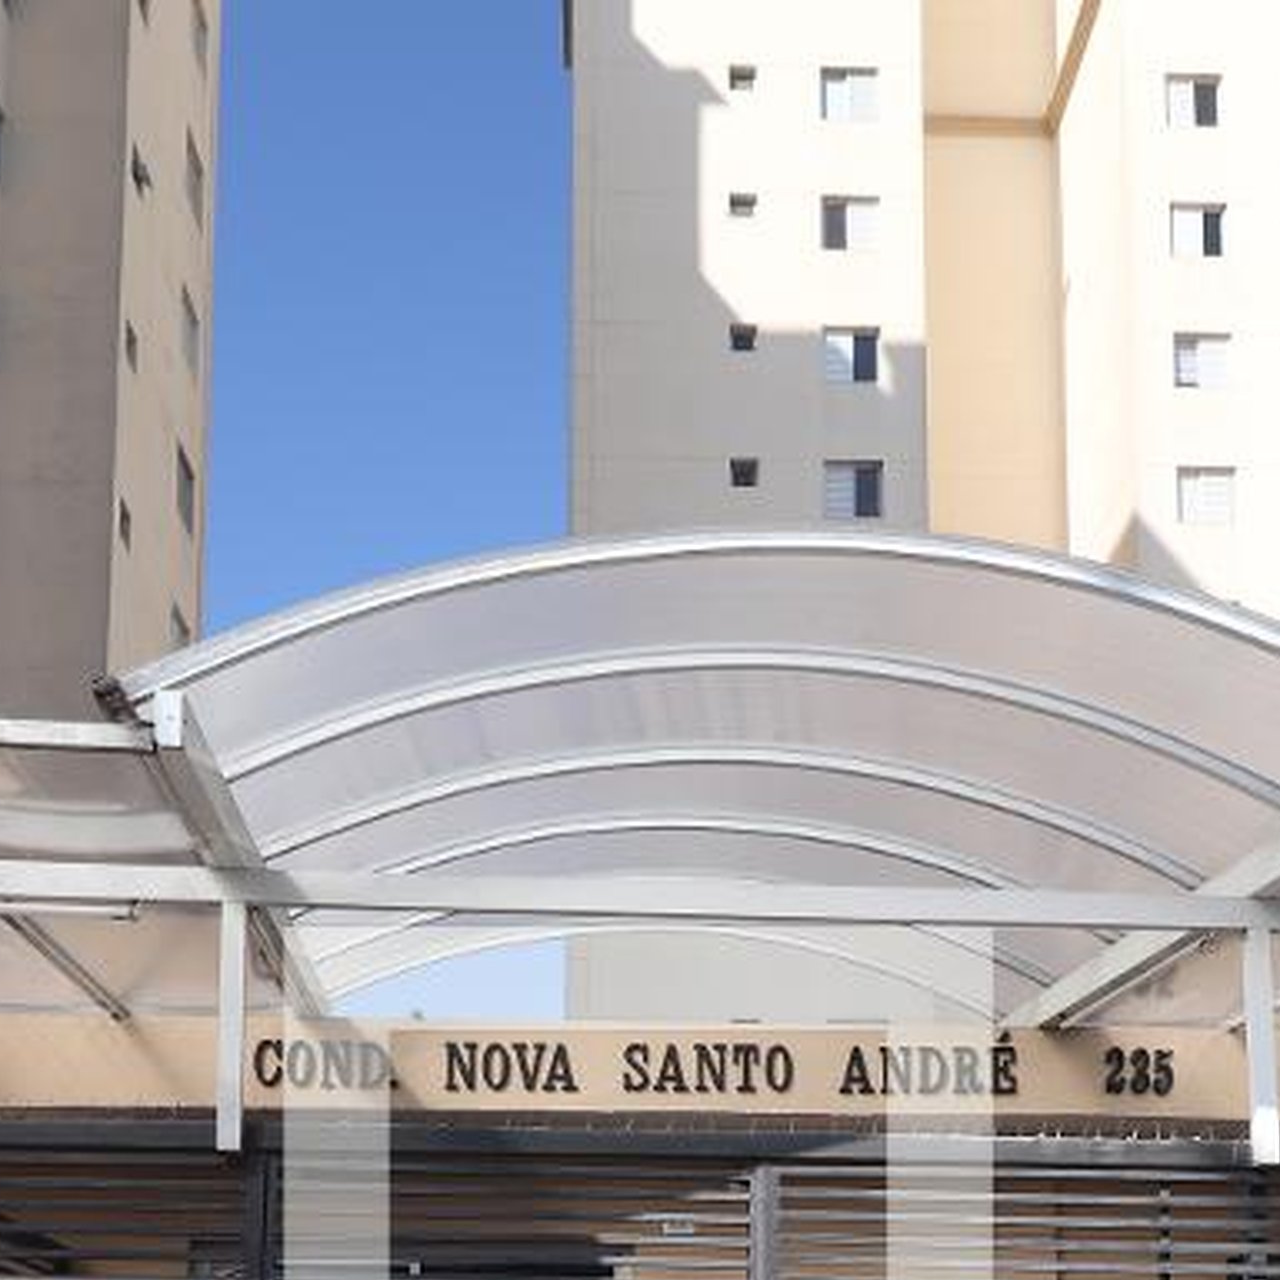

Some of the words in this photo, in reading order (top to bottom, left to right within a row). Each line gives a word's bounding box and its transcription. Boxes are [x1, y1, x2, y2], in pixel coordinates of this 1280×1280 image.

[253, 1039, 401, 1090] COND.
[443, 1041, 579, 1092] NOVA
[622, 1042, 795, 1094] SANTO
[838, 1030, 1018, 1095] ANDRÉ
